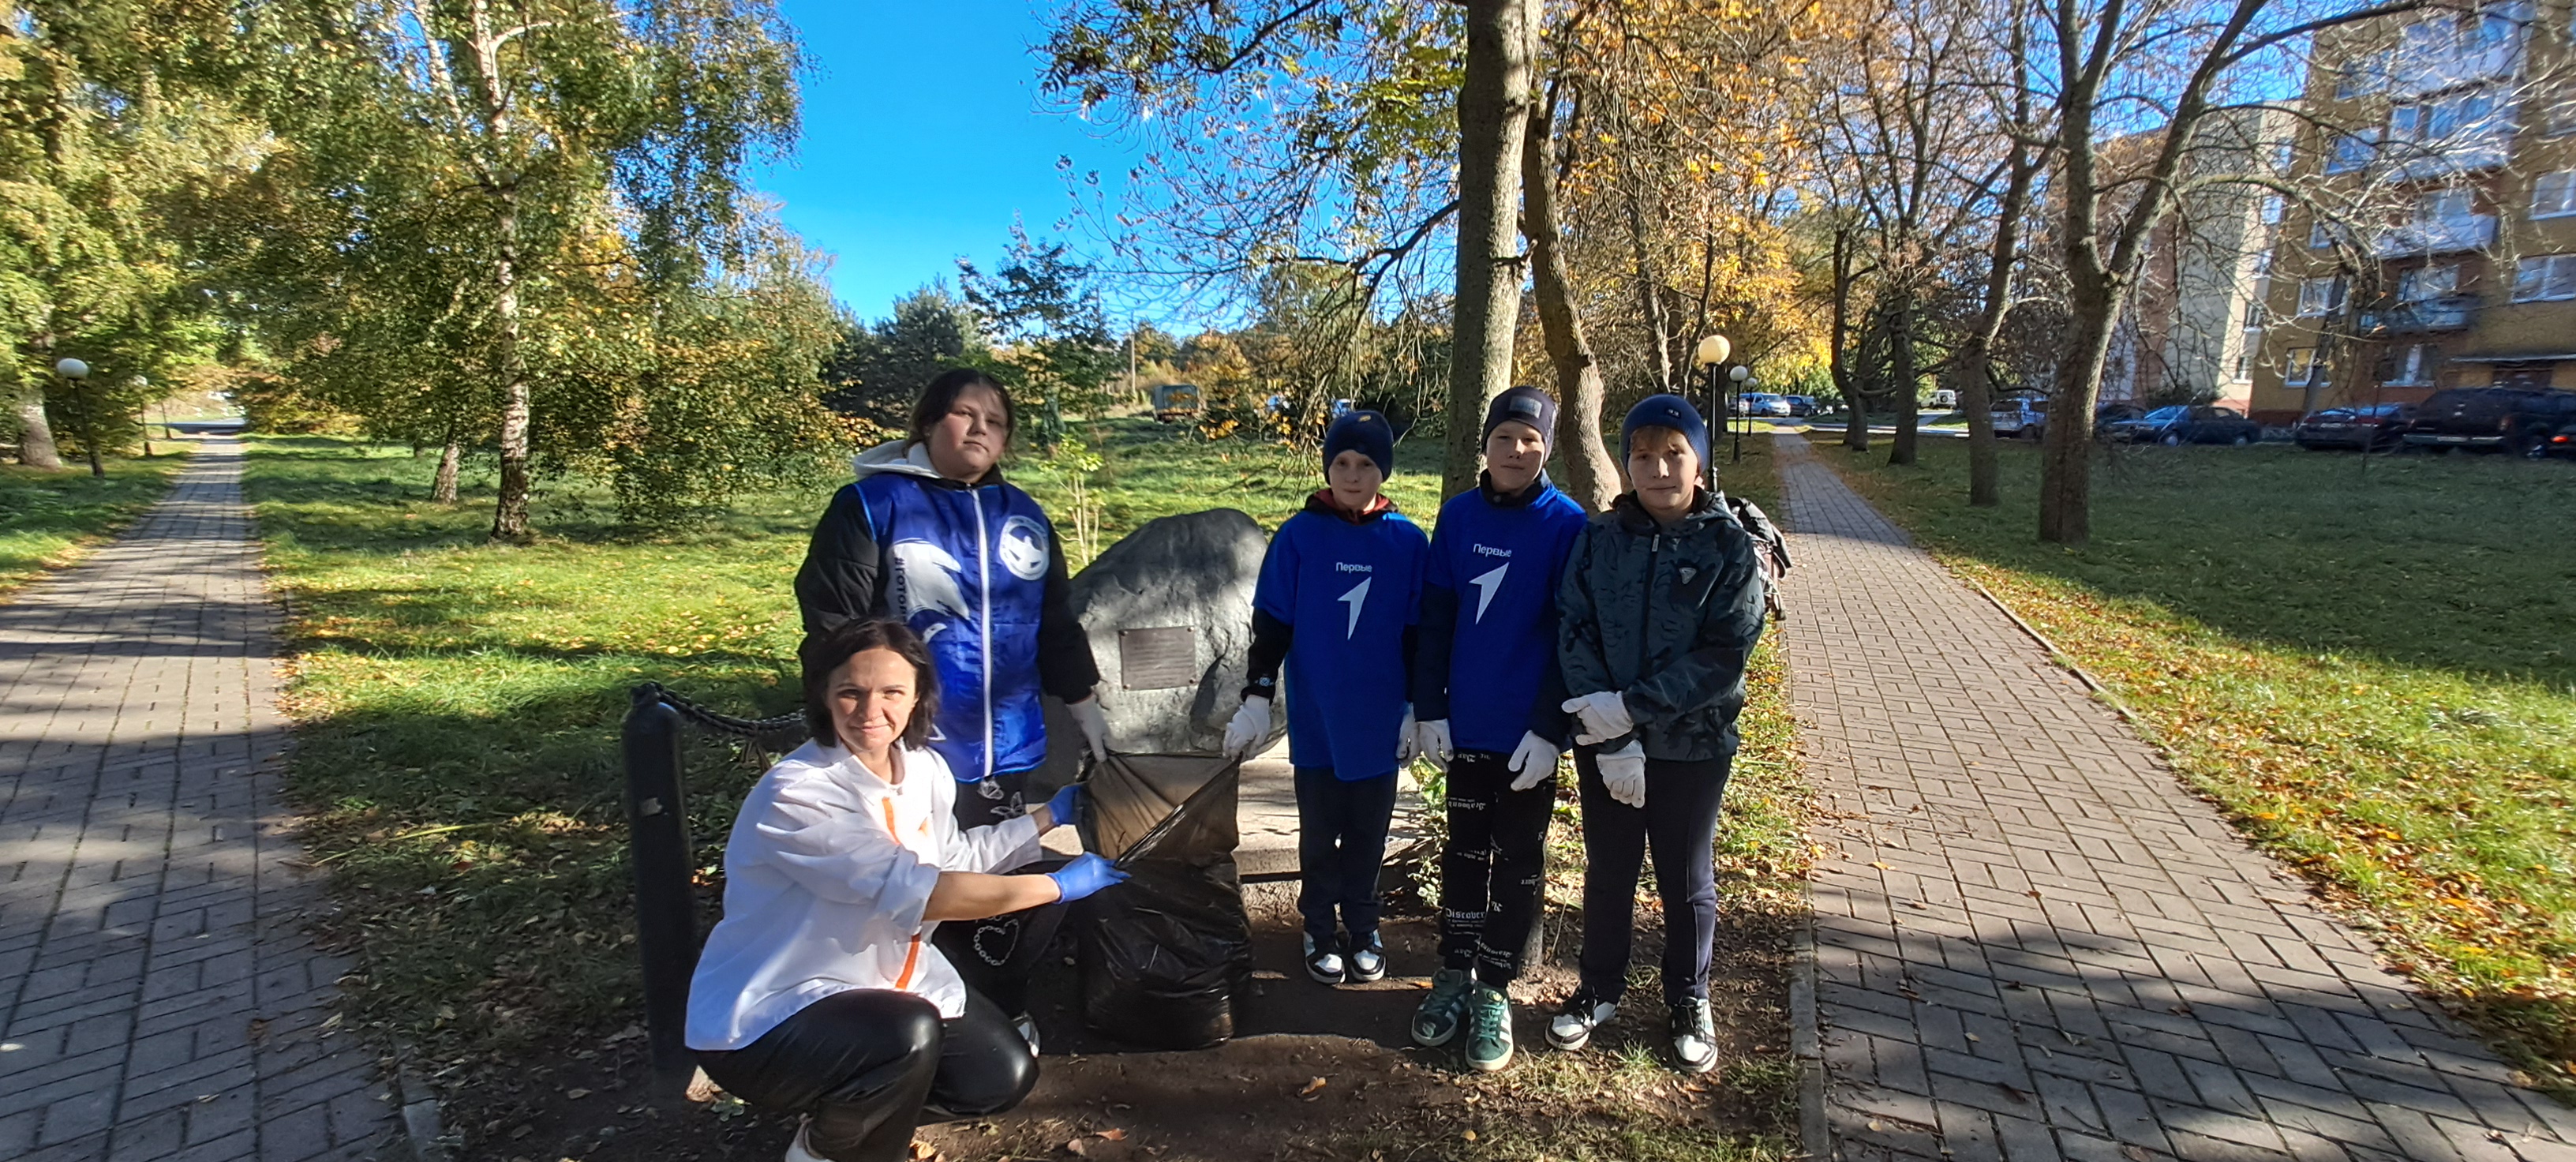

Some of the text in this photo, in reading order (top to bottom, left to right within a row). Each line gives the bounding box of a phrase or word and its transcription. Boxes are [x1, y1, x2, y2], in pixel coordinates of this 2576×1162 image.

[1473, 543, 1512, 557] Первые
[1335, 561, 1372, 574] Первые
[1444, 907, 1486, 920] Discover
